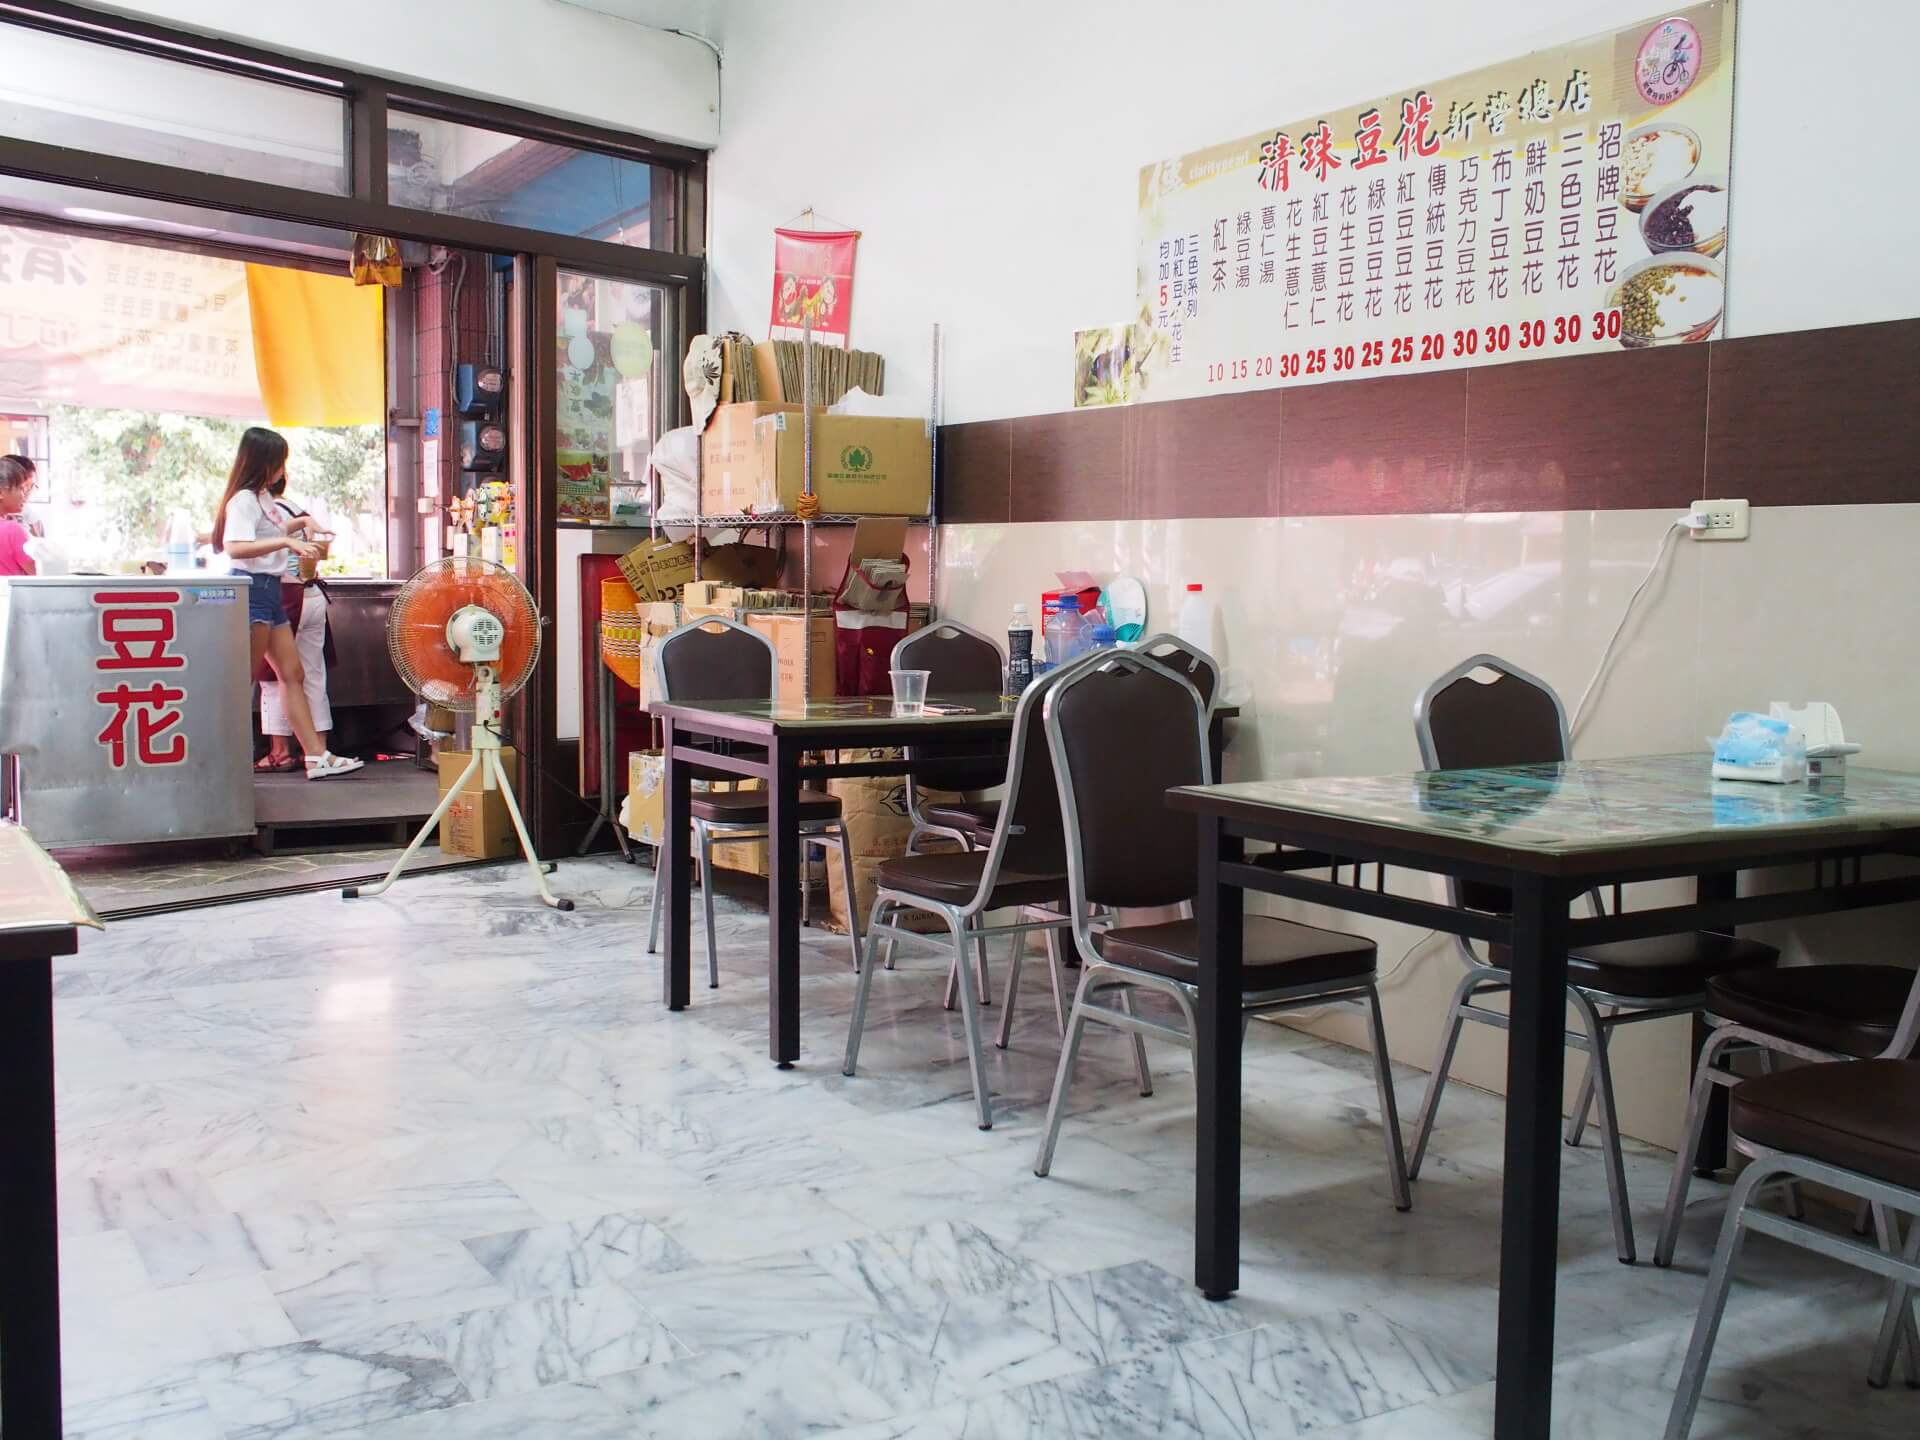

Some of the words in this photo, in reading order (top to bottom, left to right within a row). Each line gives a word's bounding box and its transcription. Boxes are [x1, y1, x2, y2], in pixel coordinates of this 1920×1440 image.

[1258, 90, 1441, 191] 清珠豆花
[1442, 68, 1593, 143] 新營總店
[1211, 218, 1228, 293] 紅茶
[1235, 210, 1251, 289] 綠豆湯
[1259, 205, 1277, 285] 薏仁湯
[1283, 196, 1303, 331] 花生薏仁
[1309, 191, 1330, 327] 紅豆薏仁
[1336, 184, 1358, 323] 花生豆花
[1364, 178, 1386, 320] 綠豆豆花
[1393, 171, 1416, 315] 紅豆豆花
[1423, 163, 1448, 310] 傳統豆花
[1455, 155, 1480, 306] 巧克力豆花
[1487, 148, 1513, 301] 布丁豆花
[1521, 139, 1548, 296] 鮮奶豆花
[1556, 132, 1584, 291] 三色豆花
[1593, 122, 1623, 286] 招牌豆花
[1158, 240, 1170, 329] 均加5元
[1186, 233, 1200, 319] 三色系列
[1208, 362, 1224, 383] 10
[1231, 359, 1248, 380] 15
[1255, 356, 1273, 377] 20
[1279, 352, 1300, 378] 30
[1305, 348, 1327, 375] 25
[1333, 345, 1355, 372] 30
[1361, 340, 1384, 368] 25
[1390, 336, 1414, 364] 25
[1420, 333, 1445, 362] 20
[1453, 328, 1478, 357] 30
[1484, 323, 1510, 353] 30
[1518, 319, 1546, 349] 30
[1553, 314, 1582, 345] 30
[1592, 309, 1622, 340] 30
[92, 590, 187, 769] 豆花
